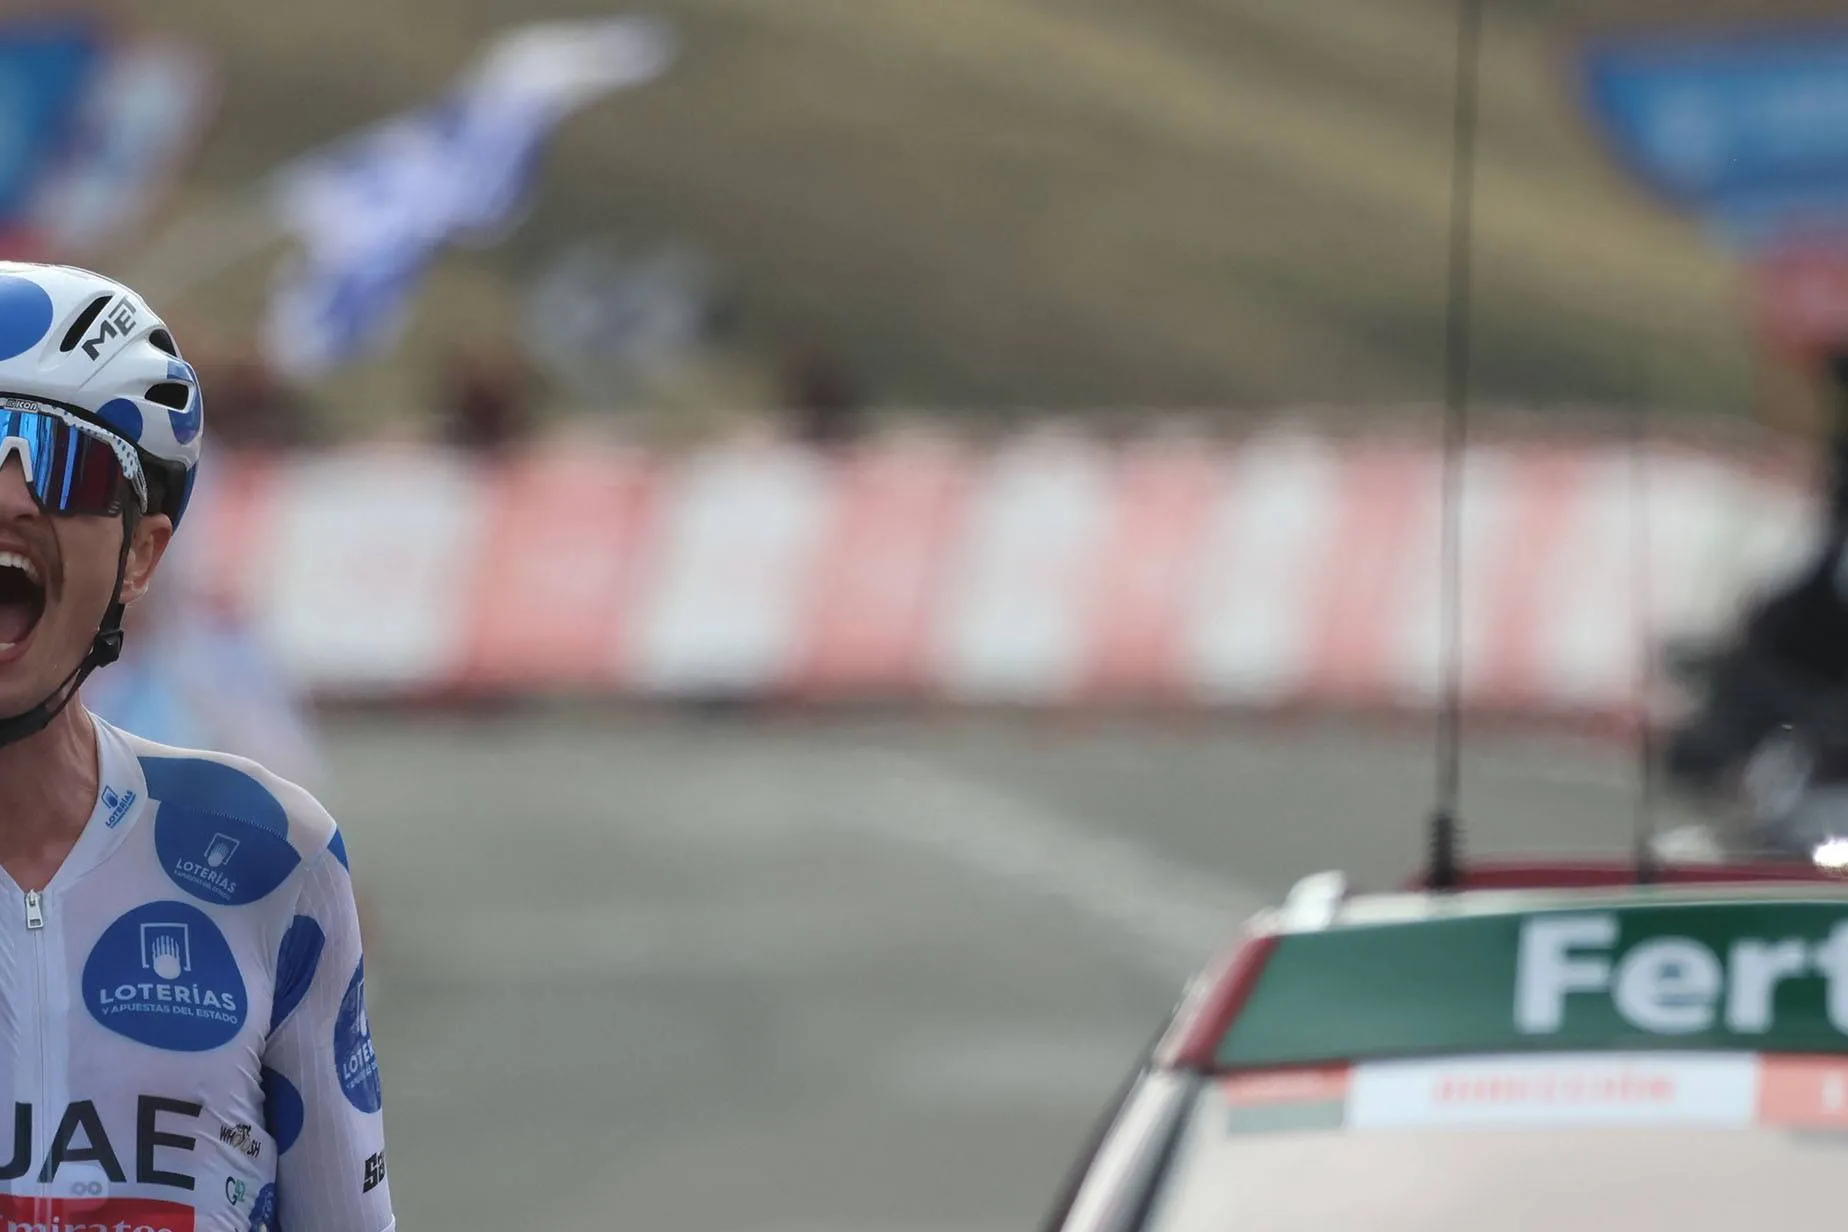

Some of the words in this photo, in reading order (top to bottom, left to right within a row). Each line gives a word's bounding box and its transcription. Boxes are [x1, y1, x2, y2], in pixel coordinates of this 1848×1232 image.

[176, 857, 238, 893] LOTERÍAS
[100, 983, 237, 1012] LOTERÍAS
[111, 1003, 170, 1015] APUESTAS
[172, 1006, 194, 1016] DEL
[196, 1008, 238, 1025] ESTADO
